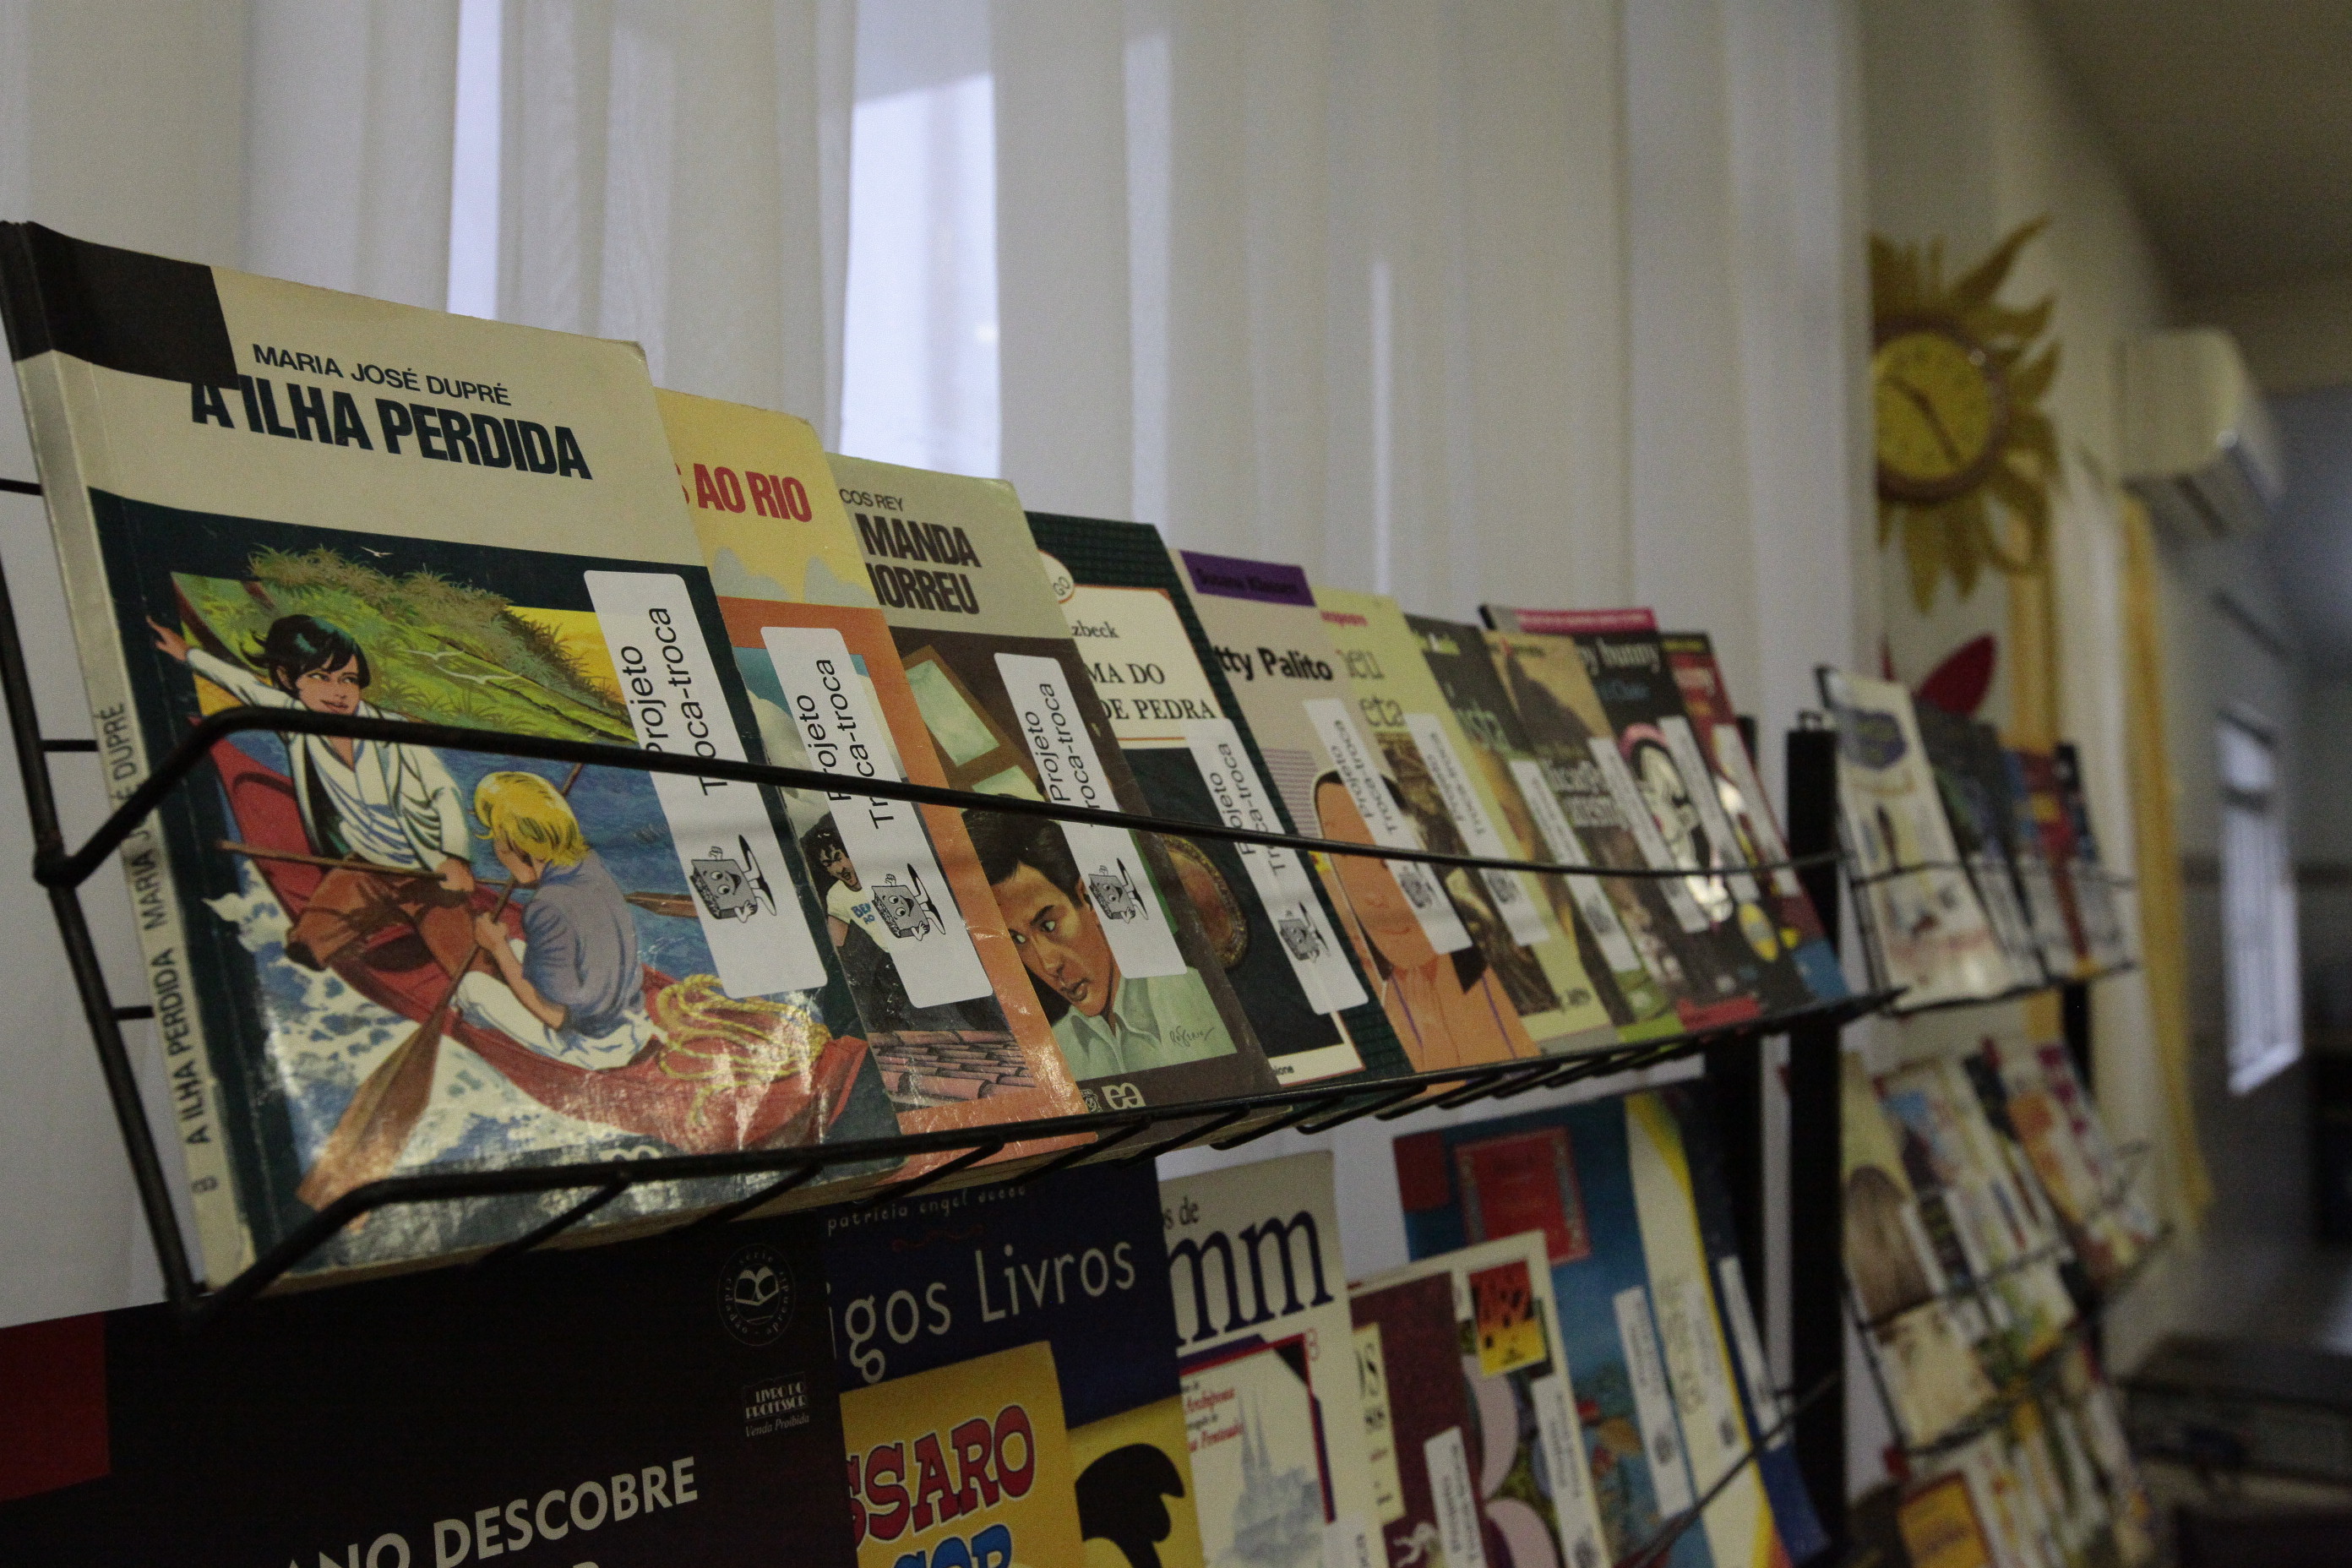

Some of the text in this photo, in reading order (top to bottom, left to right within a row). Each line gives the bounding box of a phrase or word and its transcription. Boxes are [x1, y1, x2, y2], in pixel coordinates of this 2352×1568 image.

[253, 343, 512, 406] MARIA JOSÉ DUPRÉ
[191, 373, 593, 480] A ILHA PERDIDA
[693, 462, 747, 514] AO
[744, 471, 813, 523] RIO
[839, 488, 904, 512] COS REY
[854, 512, 982, 568] MANDA
[1125, 662, 1165, 684] DO
[1256, 646, 1334, 681] Palito
[649, 607, 728, 797] Toca-troca
[1131, 699, 1217, 720] PEDRA
[100, 702, 138, 781] DUPRÉ
[816, 659, 895, 830] Trca-troca
[1025, 710, 1071, 802] Projeto
[1039, 683, 1101, 827] roca-troca
[1218, 743, 1288, 876] Trca-troca
[131, 849, 168, 931] MARIA
[151, 947, 193, 1056] PERDIDA
[173, 1059, 204, 1122] ILHA
[186, 1124, 210, 1144] A
[1179, 1196, 1200, 1225] de
[974, 1240, 1136, 1323] Livros
[745, 1394, 807, 1420] PROFESSOR
[755, 1380, 806, 1404] LIVRO DO
[745, 1412, 811, 1439] Venda Proibida
[433, 1456, 700, 1568] DESCOBRE
